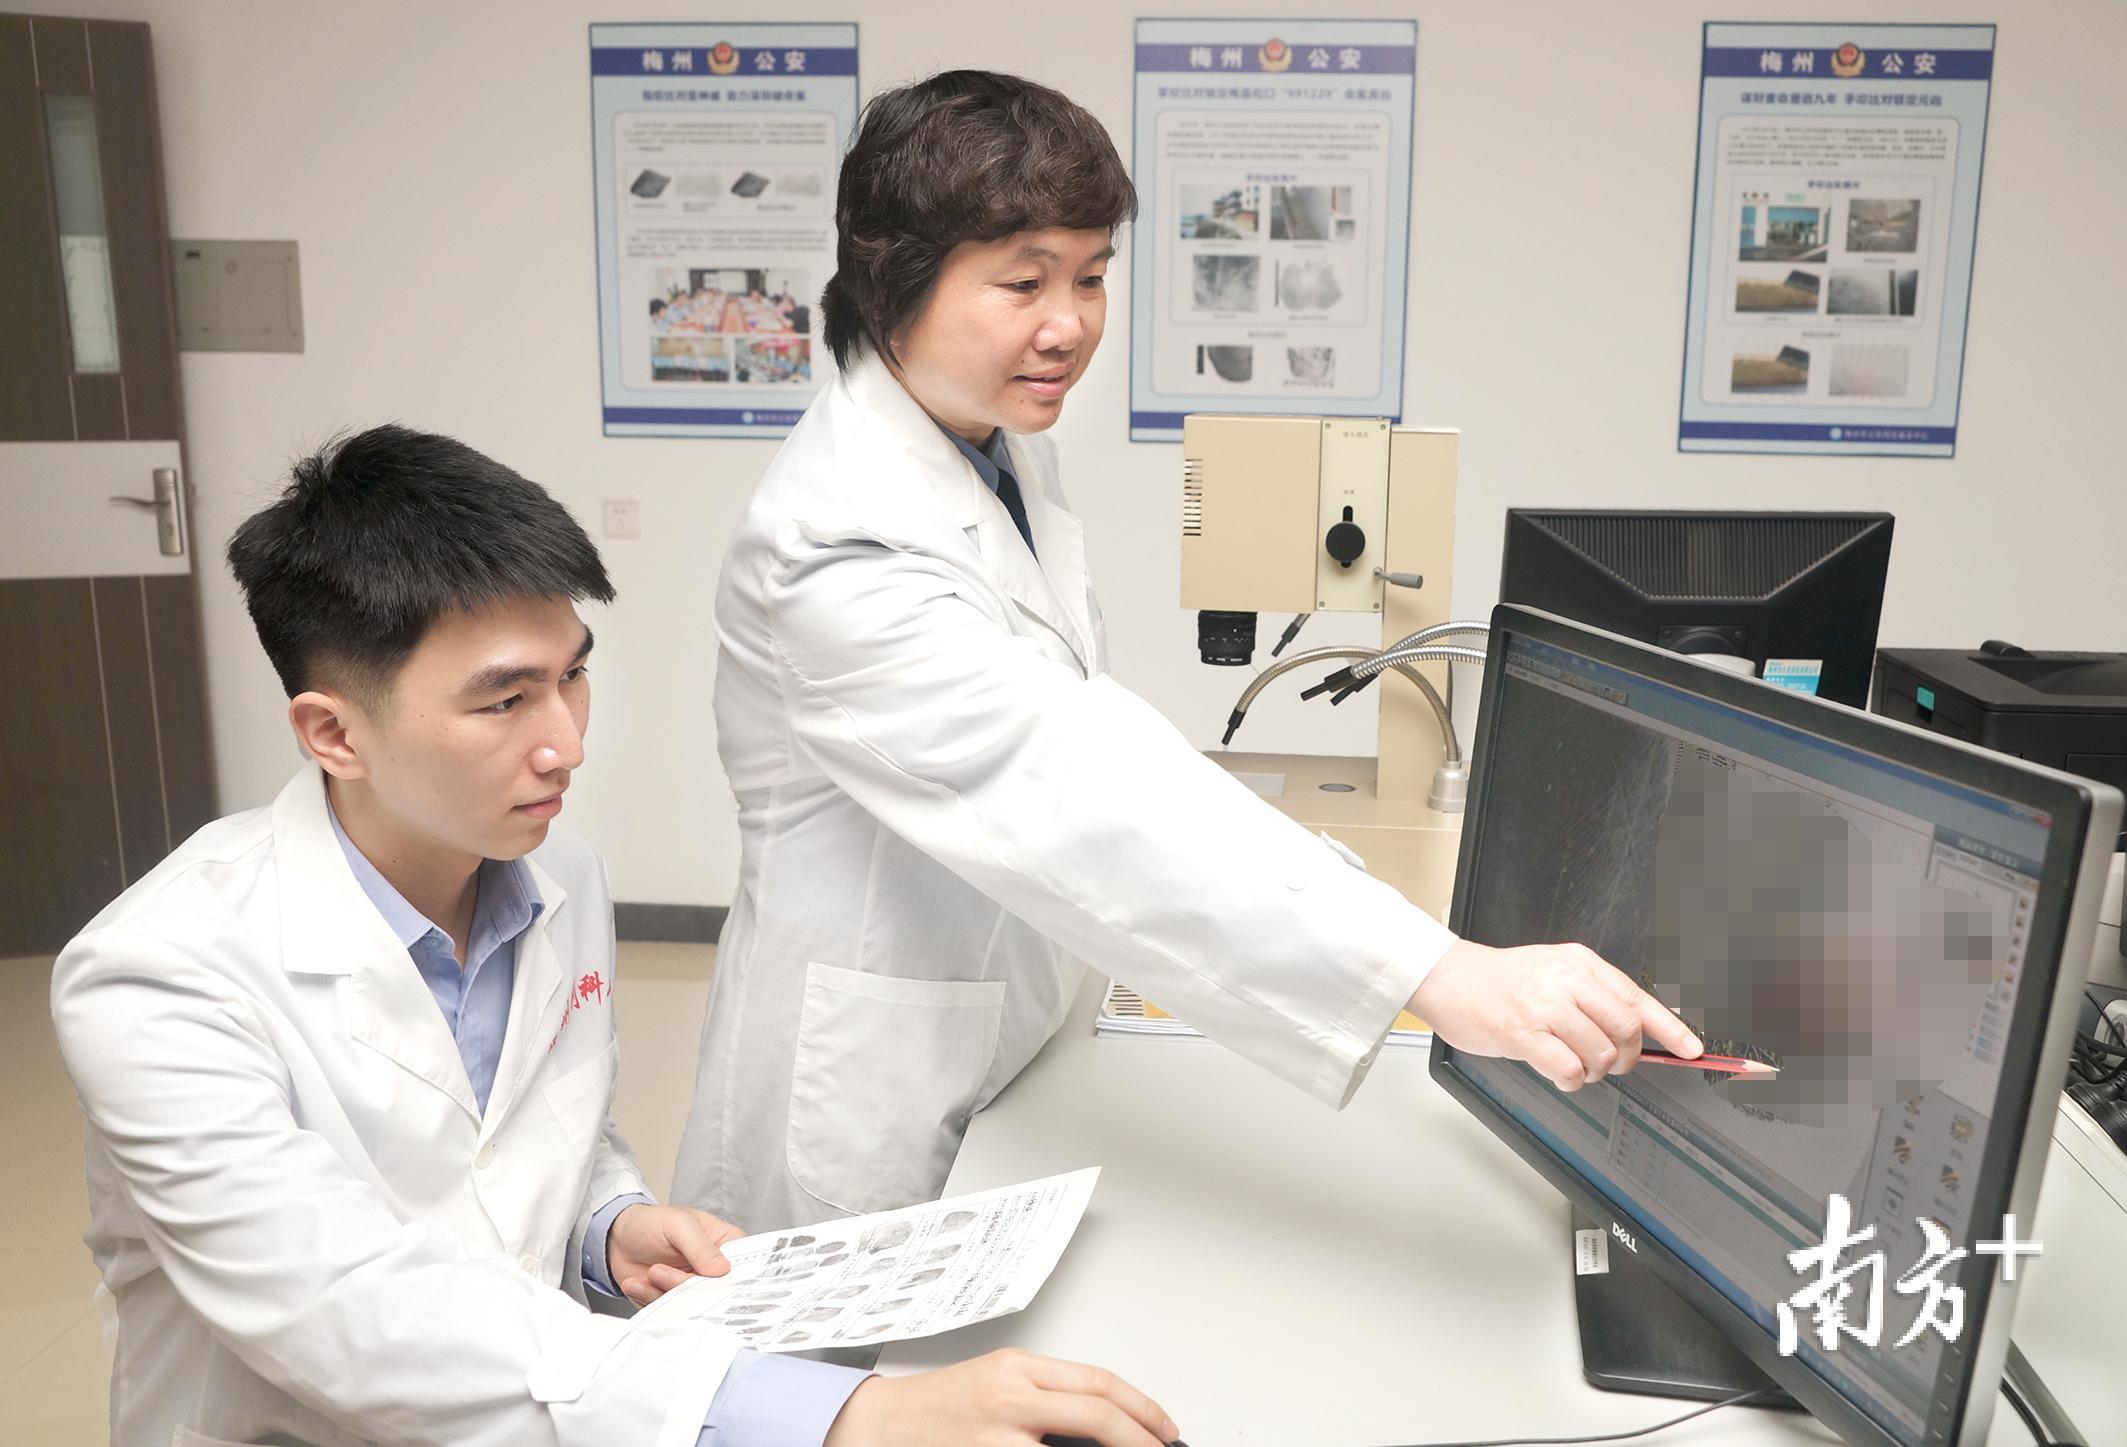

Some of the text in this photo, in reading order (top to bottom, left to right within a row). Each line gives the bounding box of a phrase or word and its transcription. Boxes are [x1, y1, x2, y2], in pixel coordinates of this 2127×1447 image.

[642, 50, 806, 72] 梅州 公安
[1190, 47, 1361, 70] 梅州 公安
[1760, 51, 1936, 75] 梅州 公安
[1612, 1221, 1638, 1254] DELL
